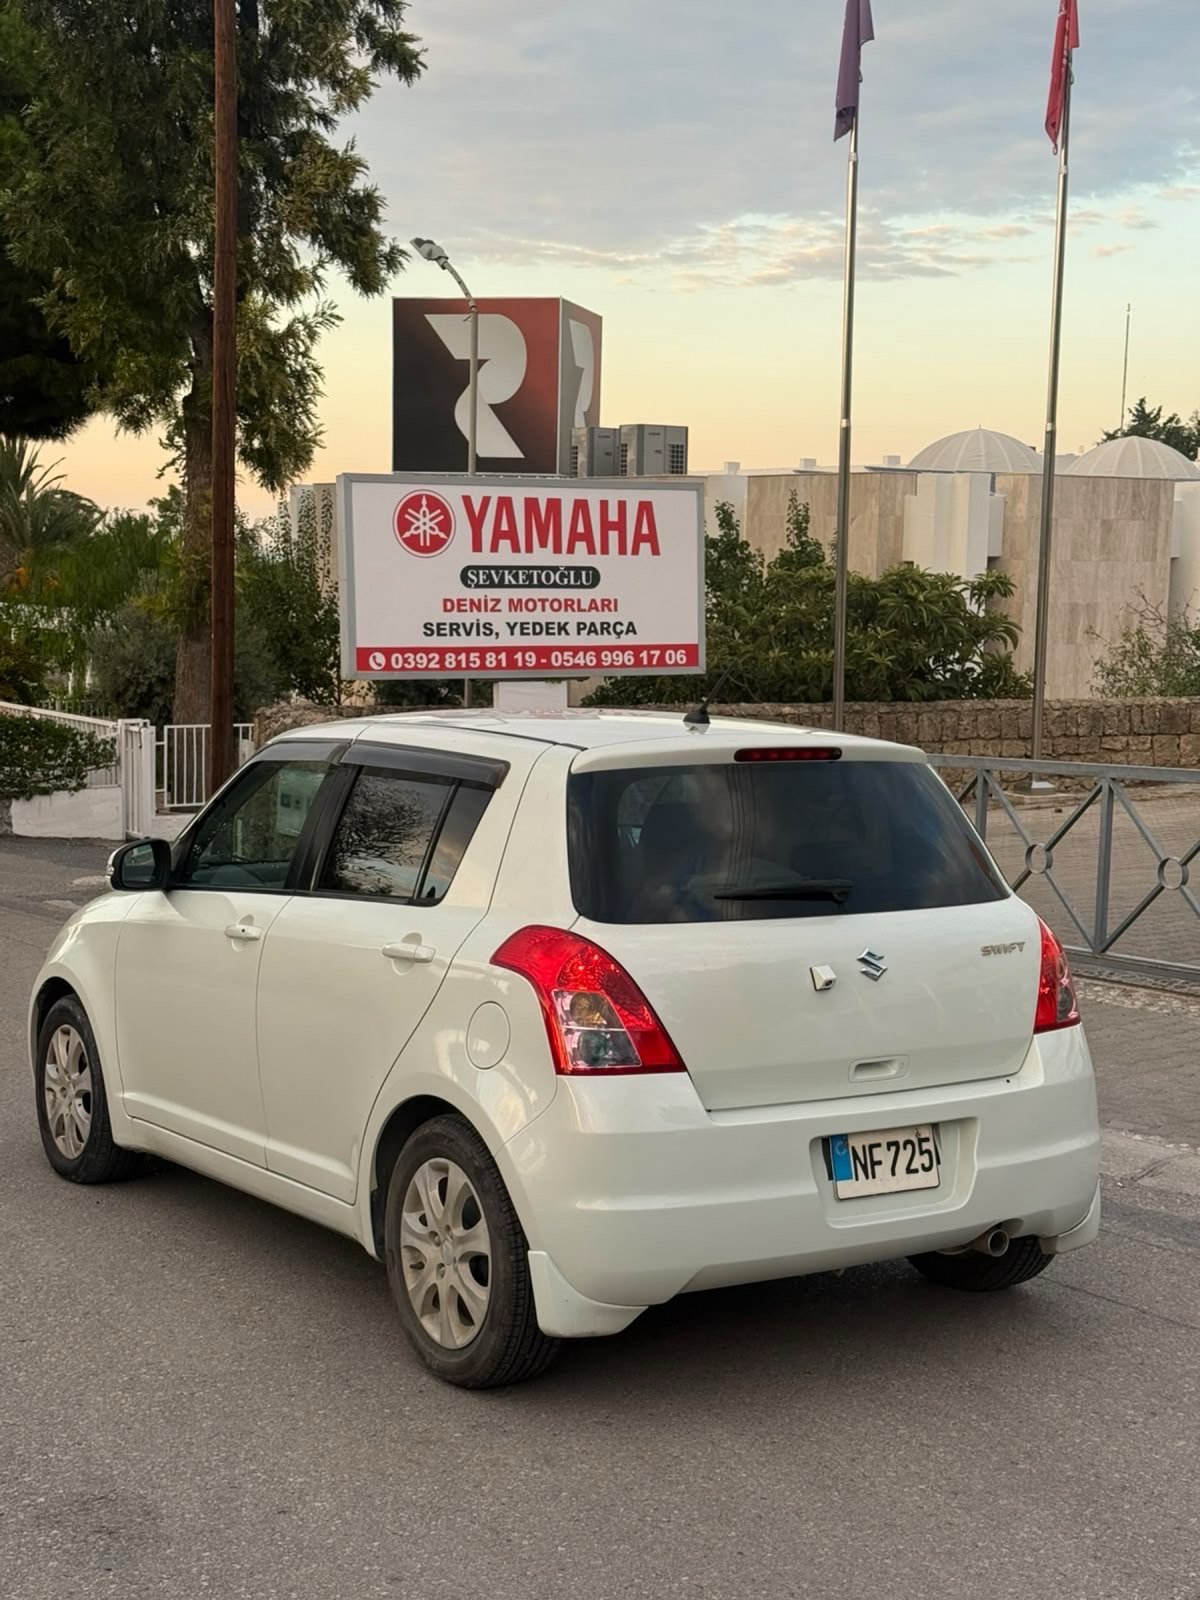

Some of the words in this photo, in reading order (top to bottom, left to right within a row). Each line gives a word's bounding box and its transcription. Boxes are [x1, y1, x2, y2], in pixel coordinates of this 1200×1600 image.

[461, 494, 661, 556] YAMAHA
[466, 566, 593, 588] ŞEVKETOĞLU
[442, 595, 502, 613] DENİZ
[508, 598, 619, 613] MOTORLARI
[422, 619, 500, 640] SERVİS,
[506, 621, 570, 637] YEDEK
[576, 621, 638, 639] PARÇA
[391, 652, 440, 669] 0392
[444, 652, 481, 668] 815
[485, 652, 507, 668] 81
[514, 651, 537, 667] 19
[551, 651, 597, 667] 0546
[601, 650, 635, 666] 996
[639, 650, 661, 665] 17
[665, 649, 687, 664] 06
[981, 941, 1025, 956] SWIFT
